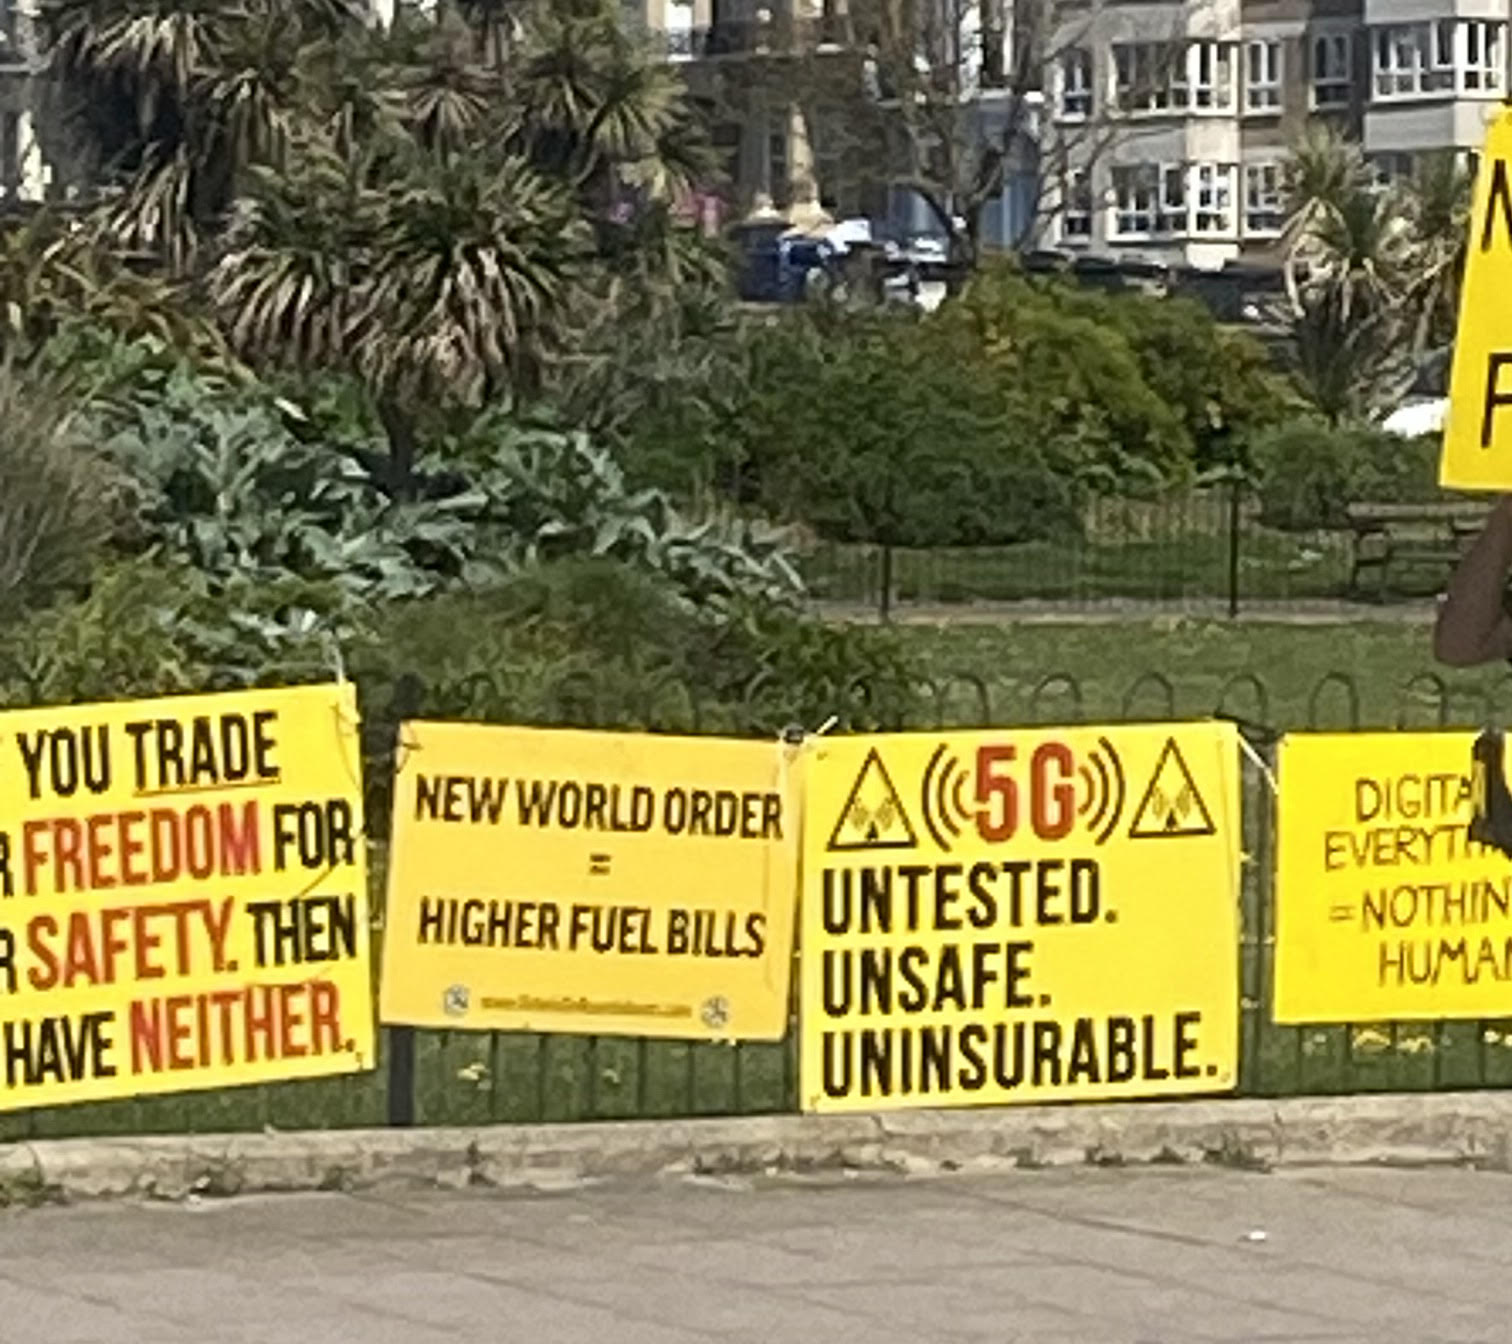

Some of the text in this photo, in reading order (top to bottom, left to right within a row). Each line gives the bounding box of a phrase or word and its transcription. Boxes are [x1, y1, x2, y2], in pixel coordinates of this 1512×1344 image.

[16, 711, 280, 799] YOU TRADE
[975, 742, 1076, 844] 5G
[414, 773, 784, 841] NEW WORLD ORDER
[1355, 773, 1475, 823] DIGITA
[22, 799, 261, 896] FREEDOM
[273, 798, 356, 873] FOR
[1324, 824, 1511, 872] EVERYT
[246, 893, 357, 968] THEN
[417, 895, 766, 958] HIGHER FUEL BILLS
[822, 858, 1118, 935] UNTESTED.
[822, 941, 1052, 1017] UNSAFE.
[3, 980, 355, 1088] HAVE NEITHER.
[822, 1012, 1219, 1098] UNINSURABLE.
